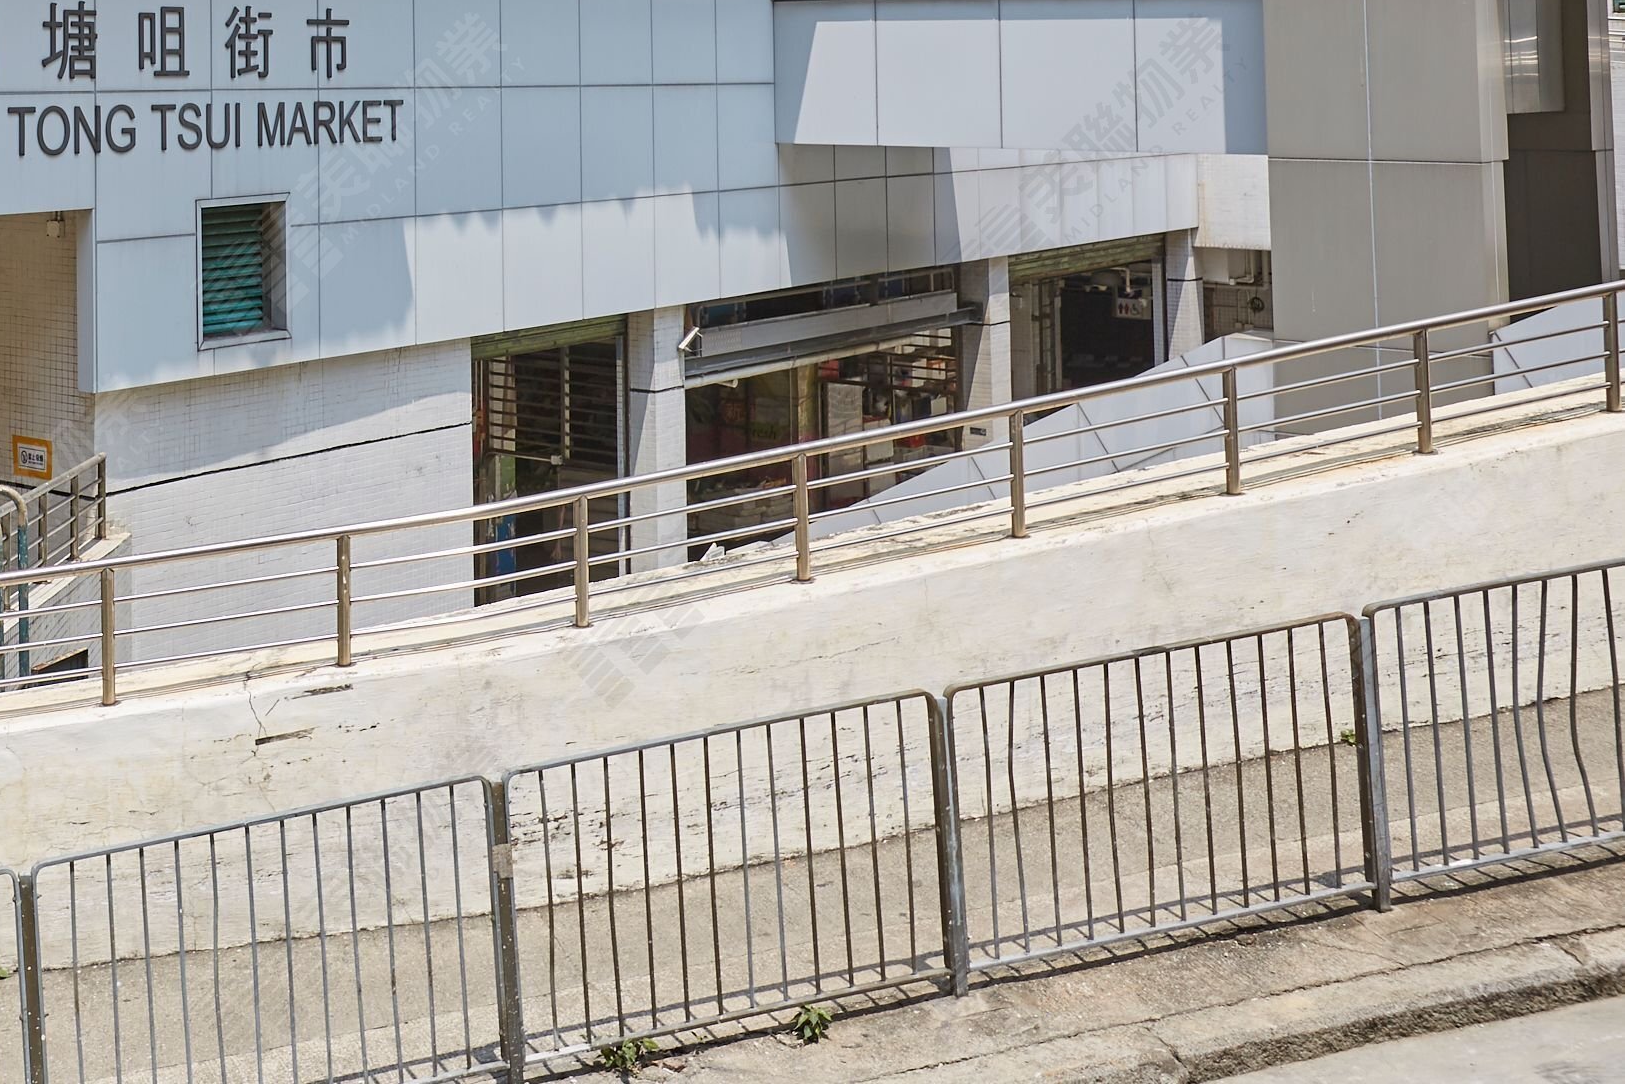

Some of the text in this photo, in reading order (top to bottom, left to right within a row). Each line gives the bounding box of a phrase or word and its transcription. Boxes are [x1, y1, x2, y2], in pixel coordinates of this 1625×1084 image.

[7, 104, 137, 158] TONG
[150, 101, 241, 152] TSUI
[257, 99, 404, 148] MARKET
